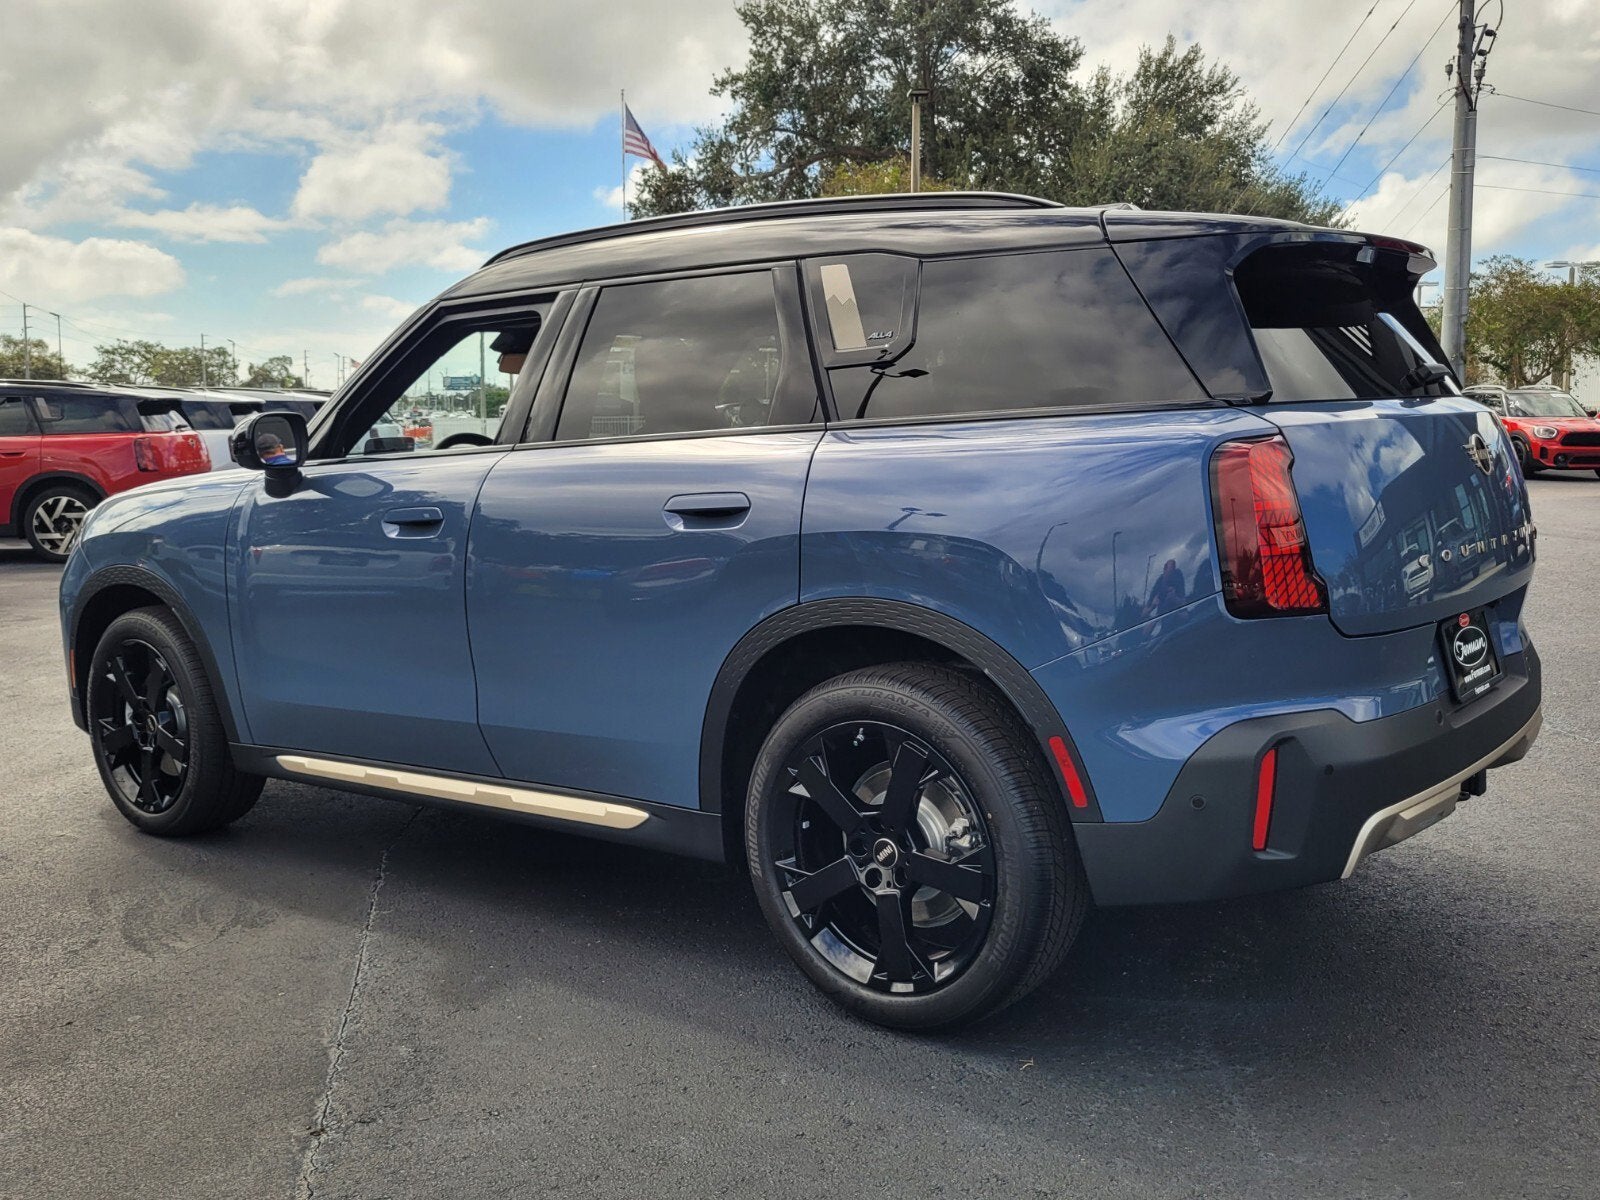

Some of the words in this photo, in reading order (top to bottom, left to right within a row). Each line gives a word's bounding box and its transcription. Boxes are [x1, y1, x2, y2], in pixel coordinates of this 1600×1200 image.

[850, 689, 931, 718] TURANZA
[748, 755, 771, 878] BRIDGESTONE
[876, 844, 893, 862] MINI
